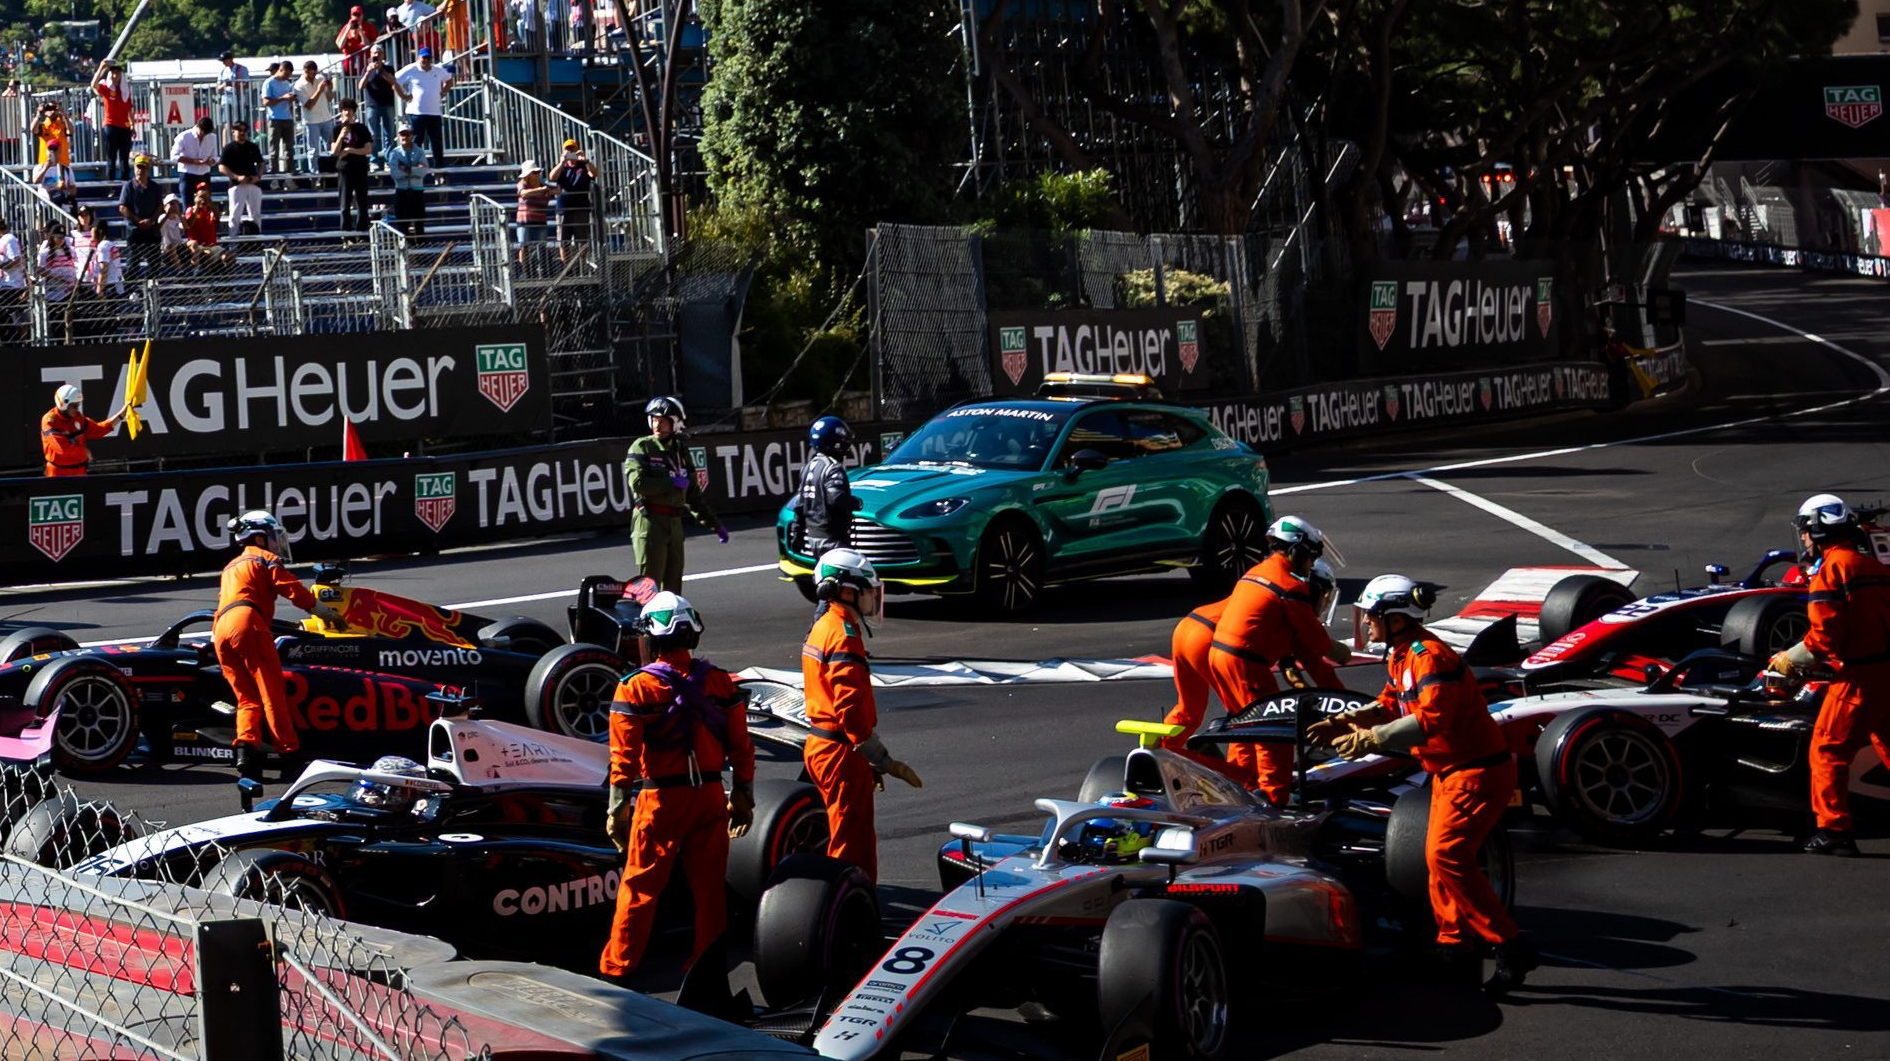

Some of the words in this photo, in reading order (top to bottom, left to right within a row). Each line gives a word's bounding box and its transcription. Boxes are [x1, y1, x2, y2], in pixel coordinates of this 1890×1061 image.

[1829, 88, 1875, 102] TAG
[167, 100, 183, 125] A
[1828, 103, 1879, 125] HEUER
[1374, 285, 1396, 306] TAG
[1003, 330, 1024, 349] TAG
[1178, 324, 1197, 342] TAG
[480, 349, 525, 372] TAG
[479, 372, 528, 407] HEUER
[946, 408, 1001, 420] ASTON
[1002, 408, 1055, 422] MARTIN
[417, 475, 454, 496] TAG
[468, 459, 632, 527] TAGHeu
[33, 498, 81, 522] TAG
[416, 497, 454, 527] HEUER
[31, 524, 82, 557] HEUER
[379, 647, 483, 667] movento
[173, 746, 235, 759] BLINKER
[493, 867, 624, 917] CONTRO
[908, 933, 955, 944] VOLITO
[882, 946, 936, 975] 8
[856, 994, 896, 1005] PIRELLI
[838, 1015, 879, 1026] TGR
